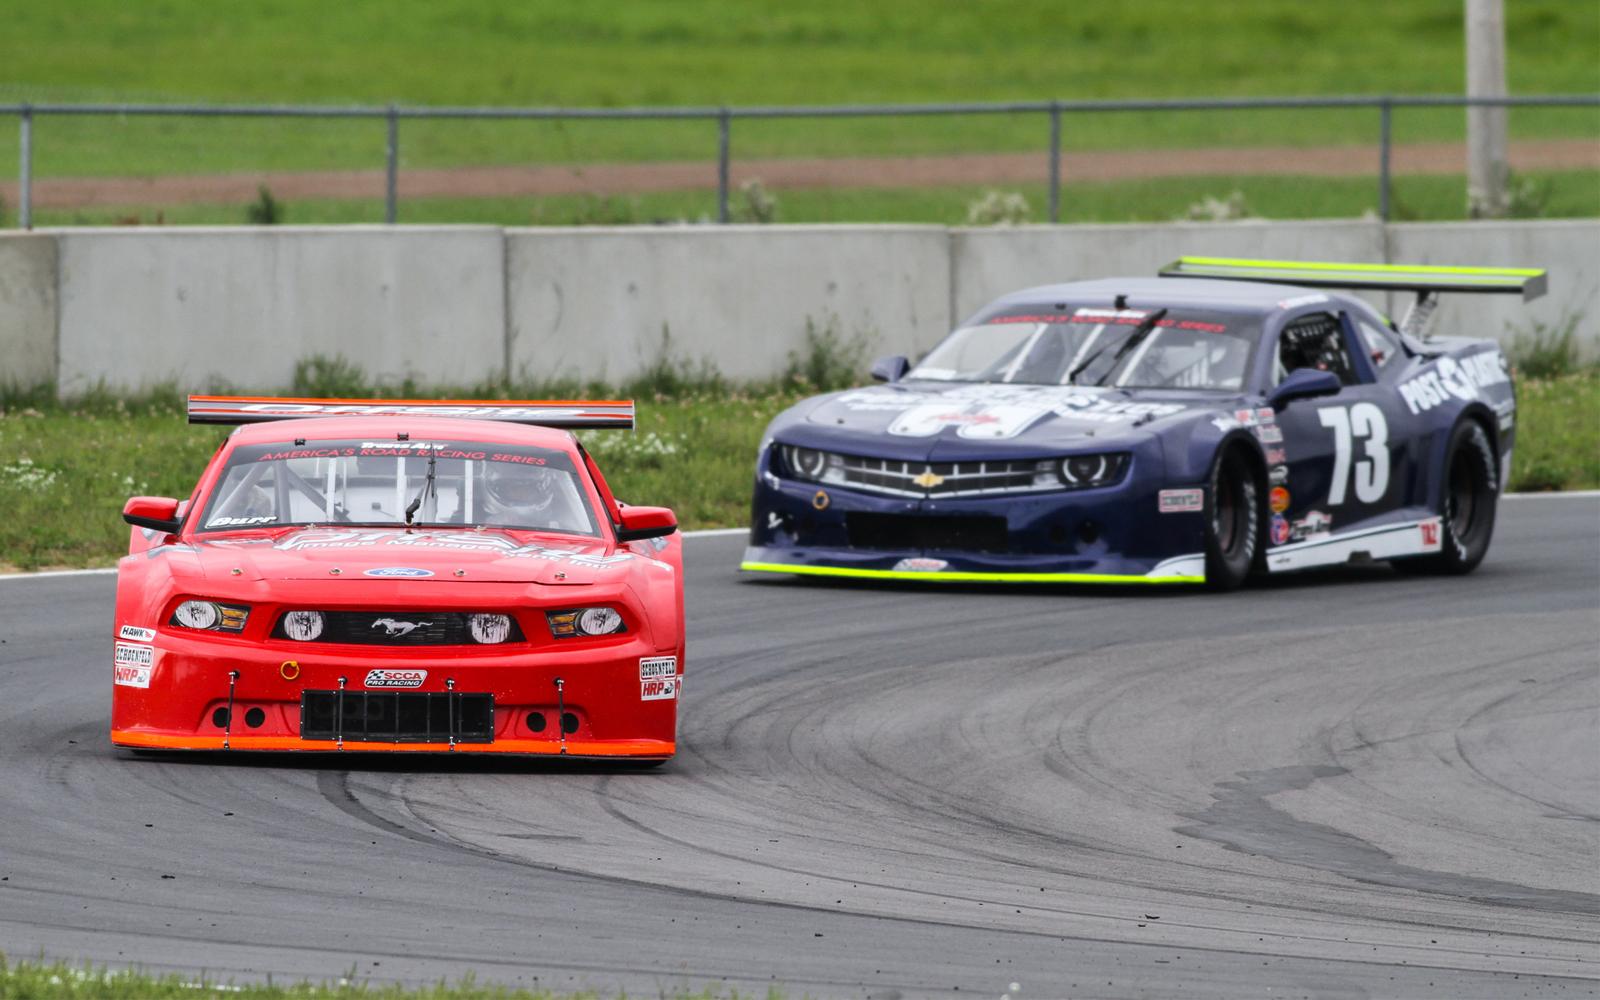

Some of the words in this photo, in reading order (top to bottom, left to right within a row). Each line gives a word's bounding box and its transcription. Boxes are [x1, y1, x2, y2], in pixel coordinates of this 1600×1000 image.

[1398, 370, 1450, 415] POST
[258, 448, 355, 461] AMERICA'S
[360, 448, 412, 457] ROAD
[416, 449, 486, 460] RACING
[491, 453, 547, 466] SERIES
[1317, 402, 1390, 506] 73
[296, 540, 376, 551] Image
[121, 626, 145, 638] HAWK
[116, 667, 139, 682] HRP
[383, 672, 422, 680] SCCA
[642, 661, 675, 677] SCHOENFELD
[643, 682, 665, 697] HRP
